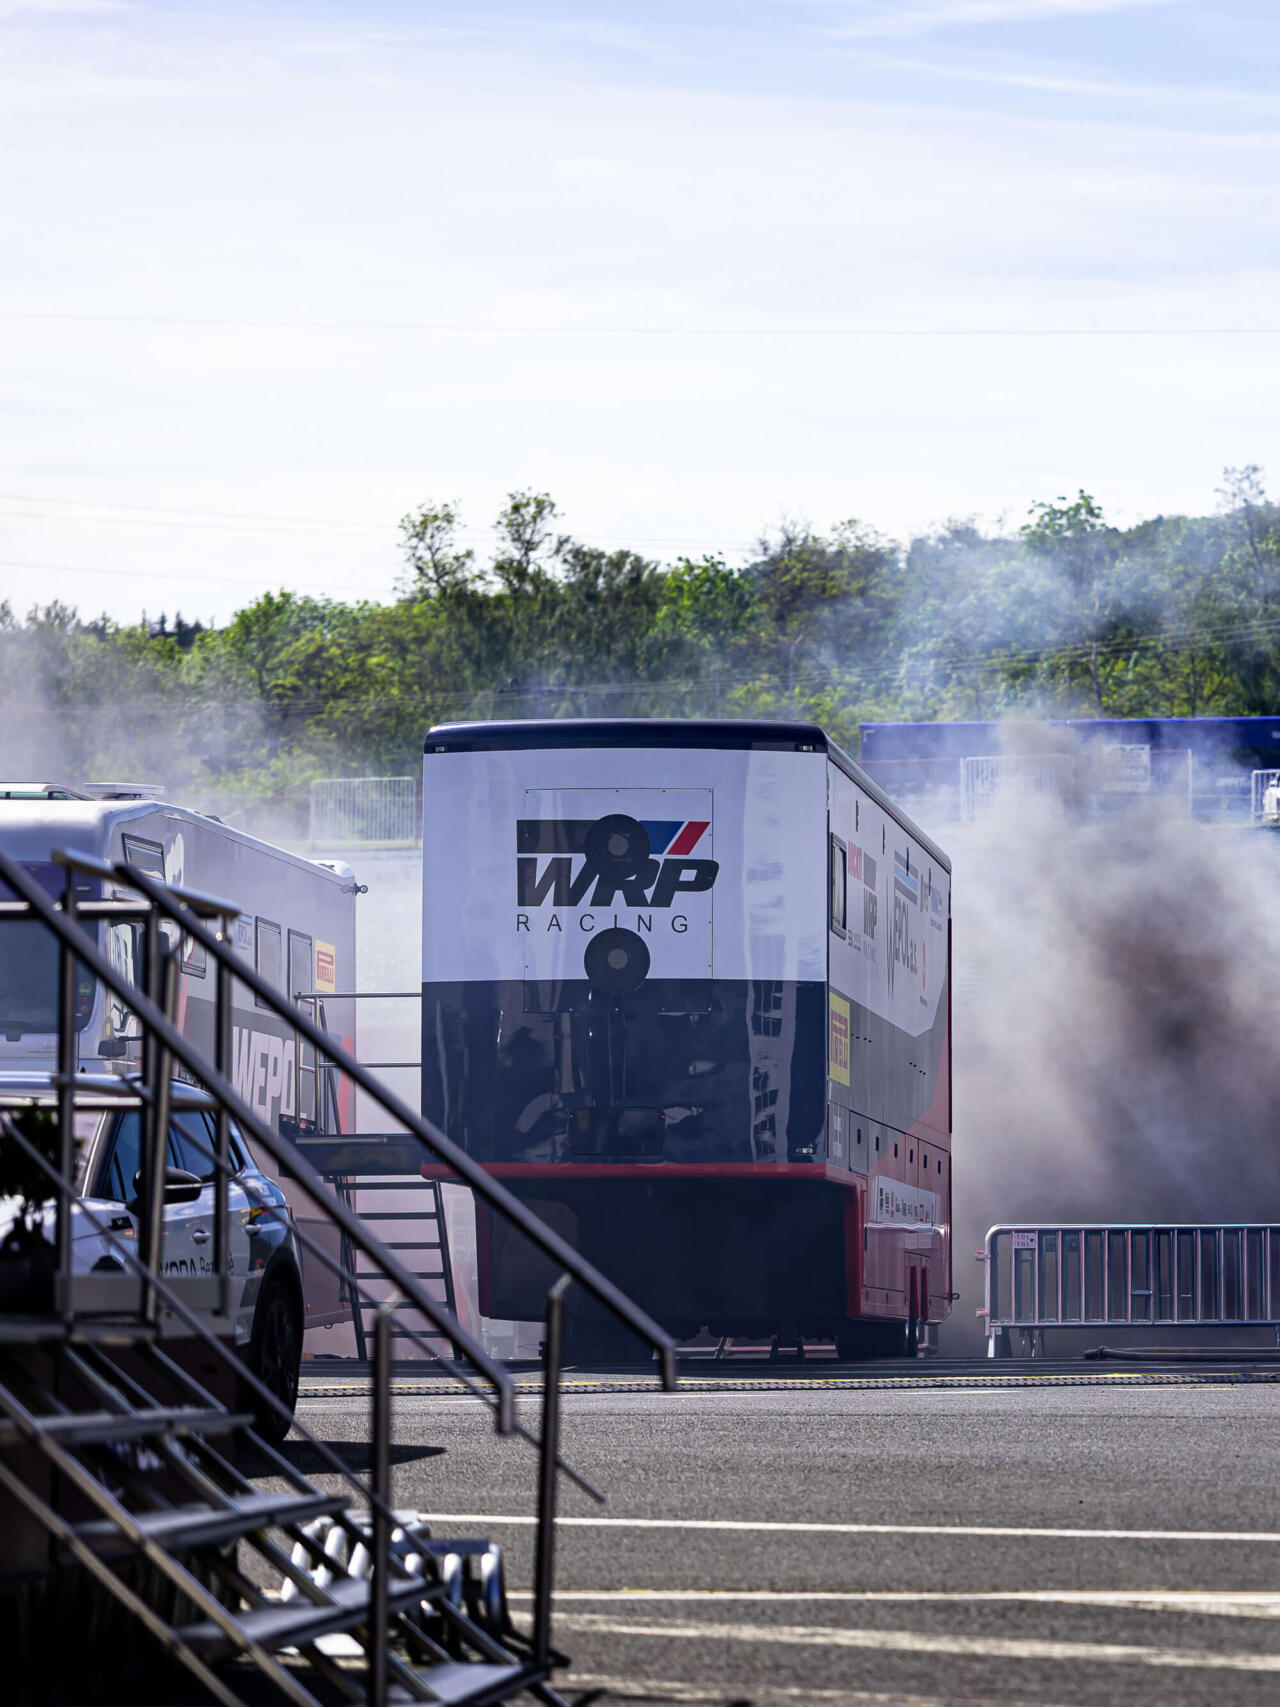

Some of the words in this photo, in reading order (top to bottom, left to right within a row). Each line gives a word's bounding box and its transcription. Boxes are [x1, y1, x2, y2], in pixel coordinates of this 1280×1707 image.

[517, 857, 720, 907] WRP
[517, 914, 688, 933] RACING
[316, 950, 334, 984] PIRELLI
